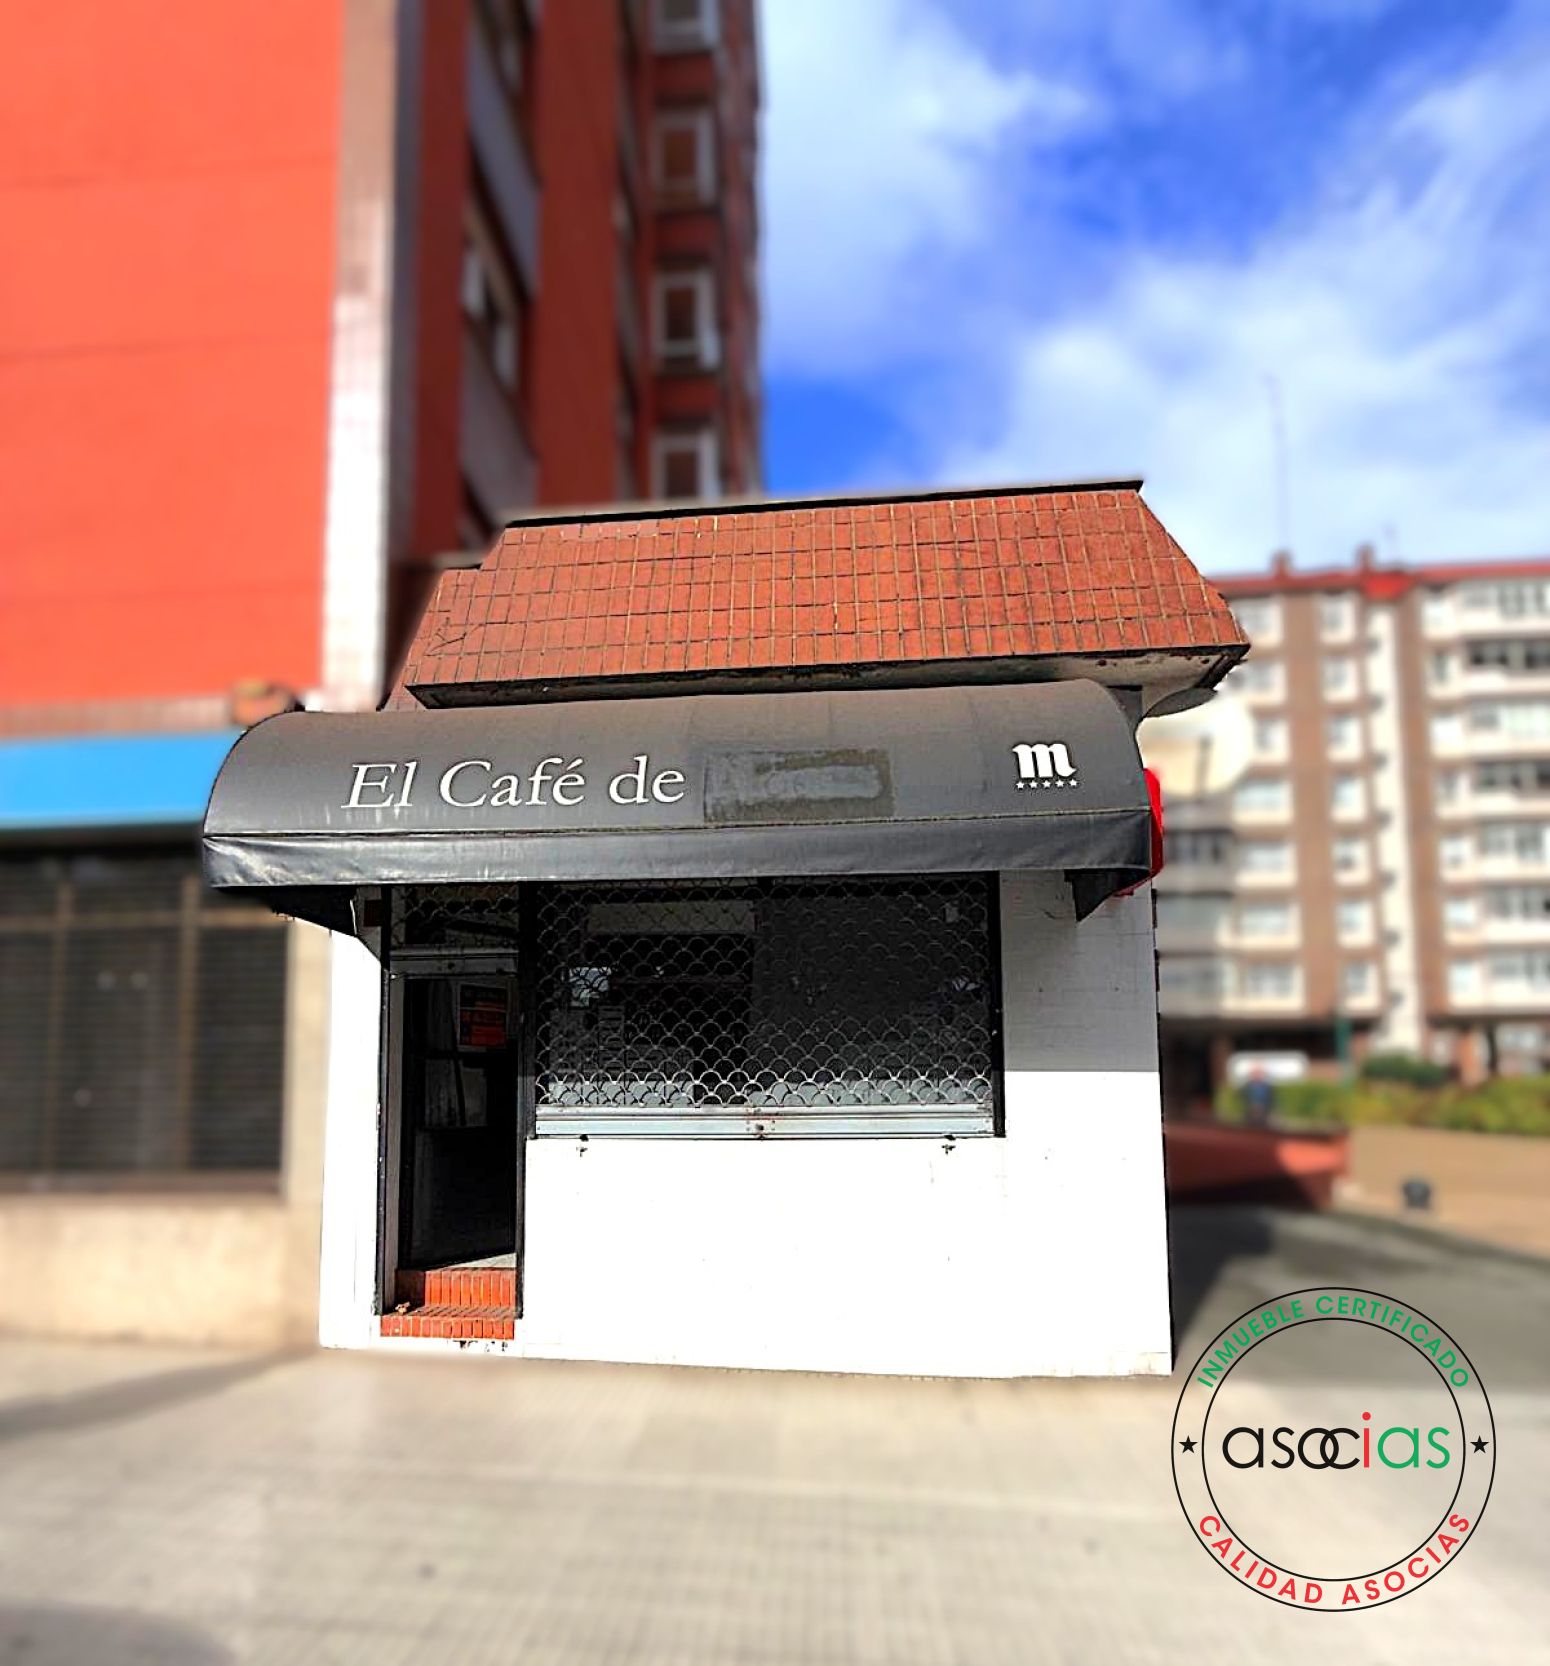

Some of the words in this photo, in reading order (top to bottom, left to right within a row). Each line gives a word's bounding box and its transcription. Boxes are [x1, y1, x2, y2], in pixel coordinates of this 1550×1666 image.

[341, 761, 418, 808] El
[439, 757, 585, 807] Café
[609, 755, 685, 804] de
